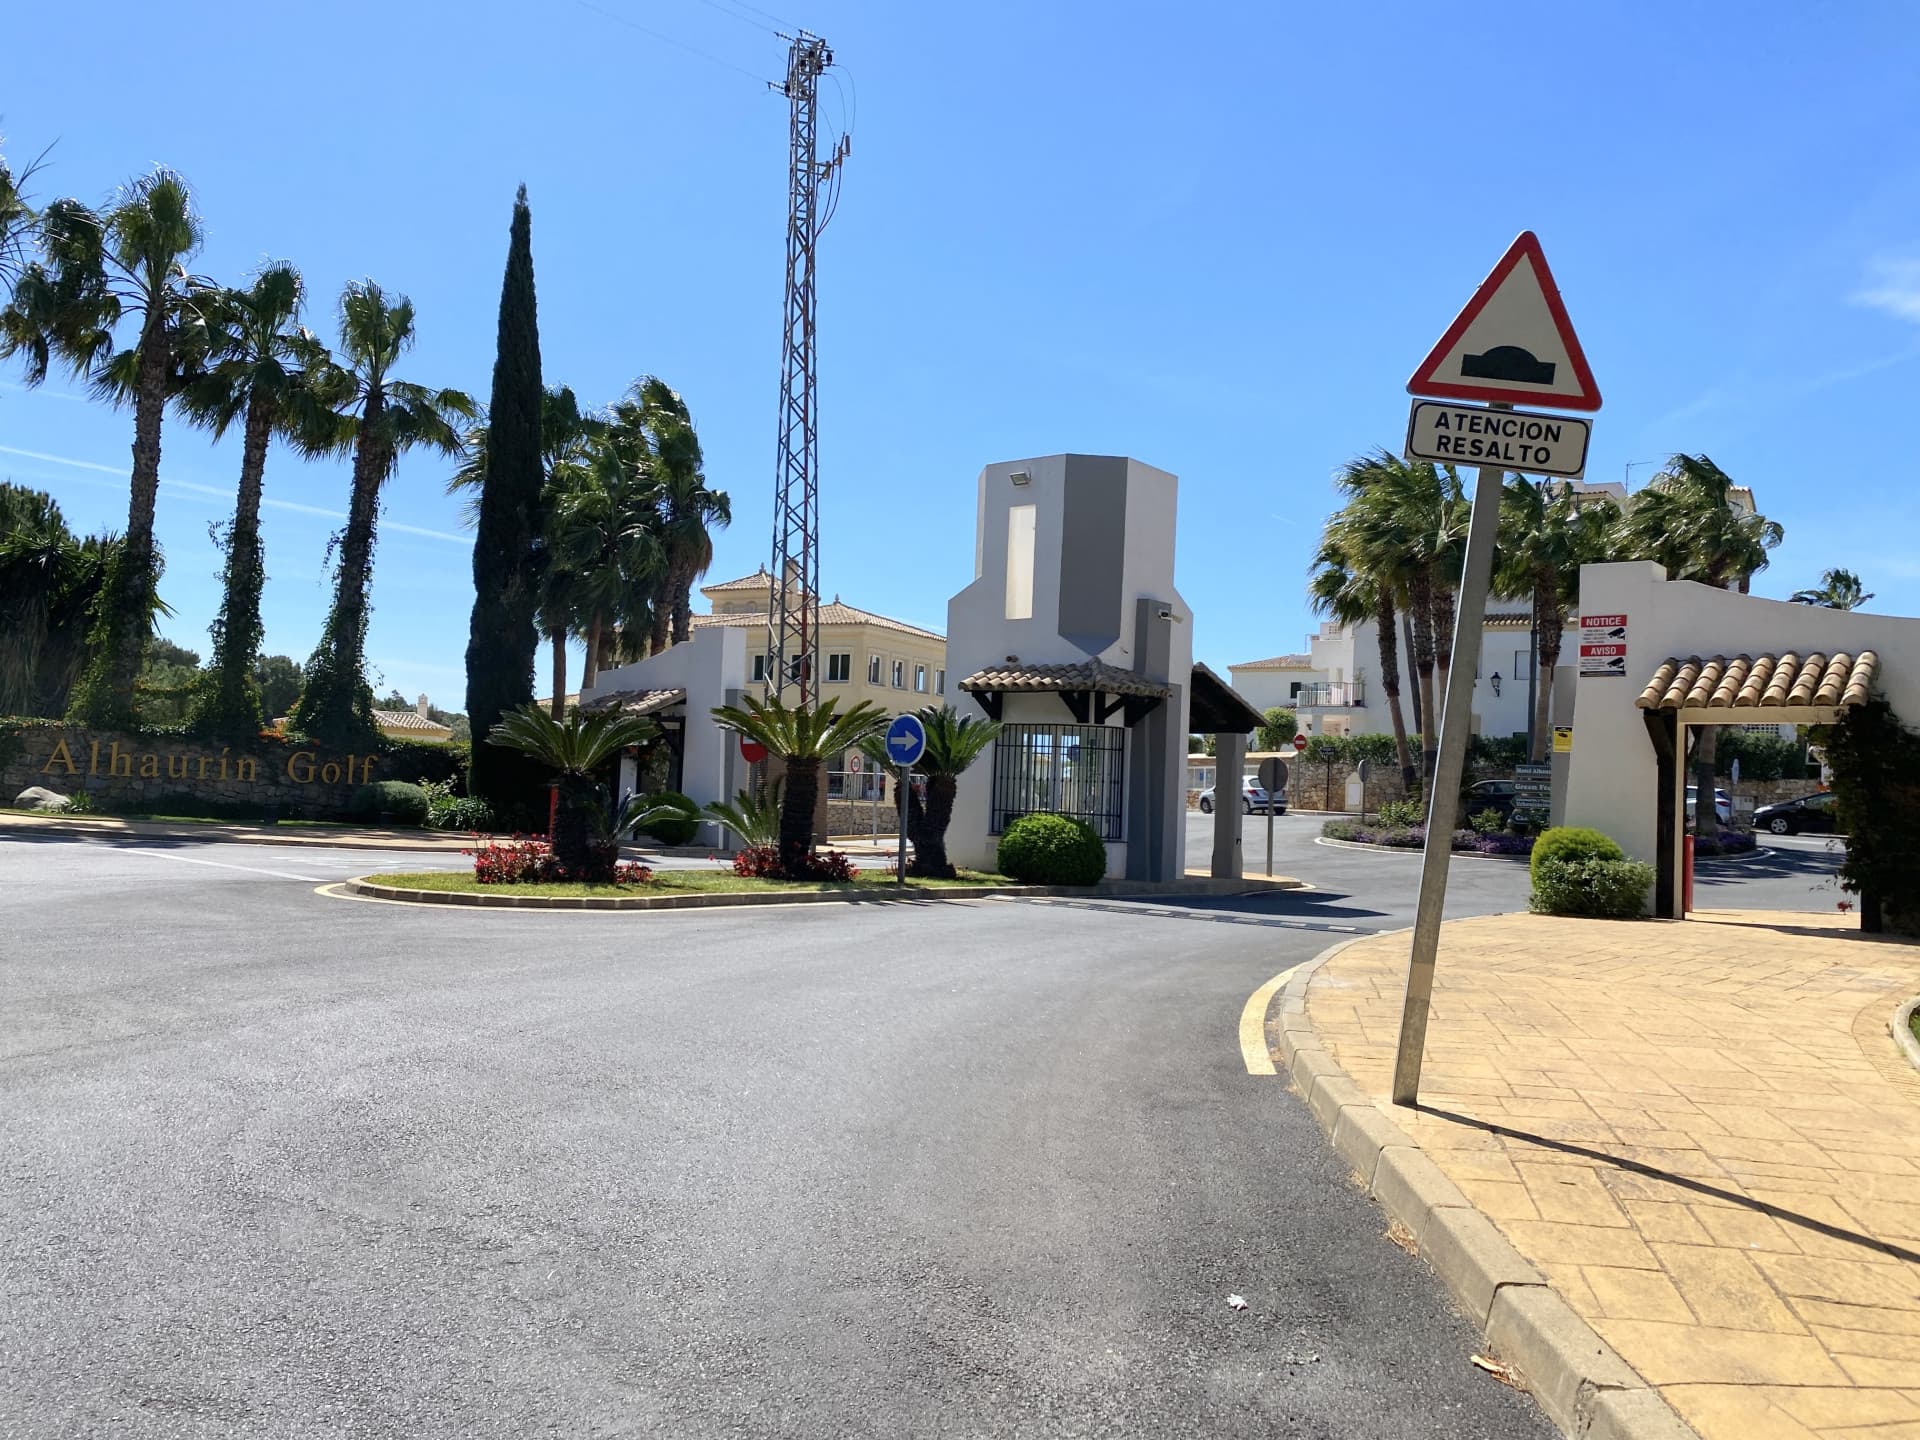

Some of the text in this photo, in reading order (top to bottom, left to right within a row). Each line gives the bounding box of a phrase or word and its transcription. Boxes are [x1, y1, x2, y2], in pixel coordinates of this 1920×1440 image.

[1434, 411, 1562, 443] ATENCION
[1436, 435, 1551, 465] RESALTO
[1586, 616, 1622, 626] NOTICE
[1590, 646, 1617, 656] AVISO
[40, 738, 379, 785] Alhaurín Golf
